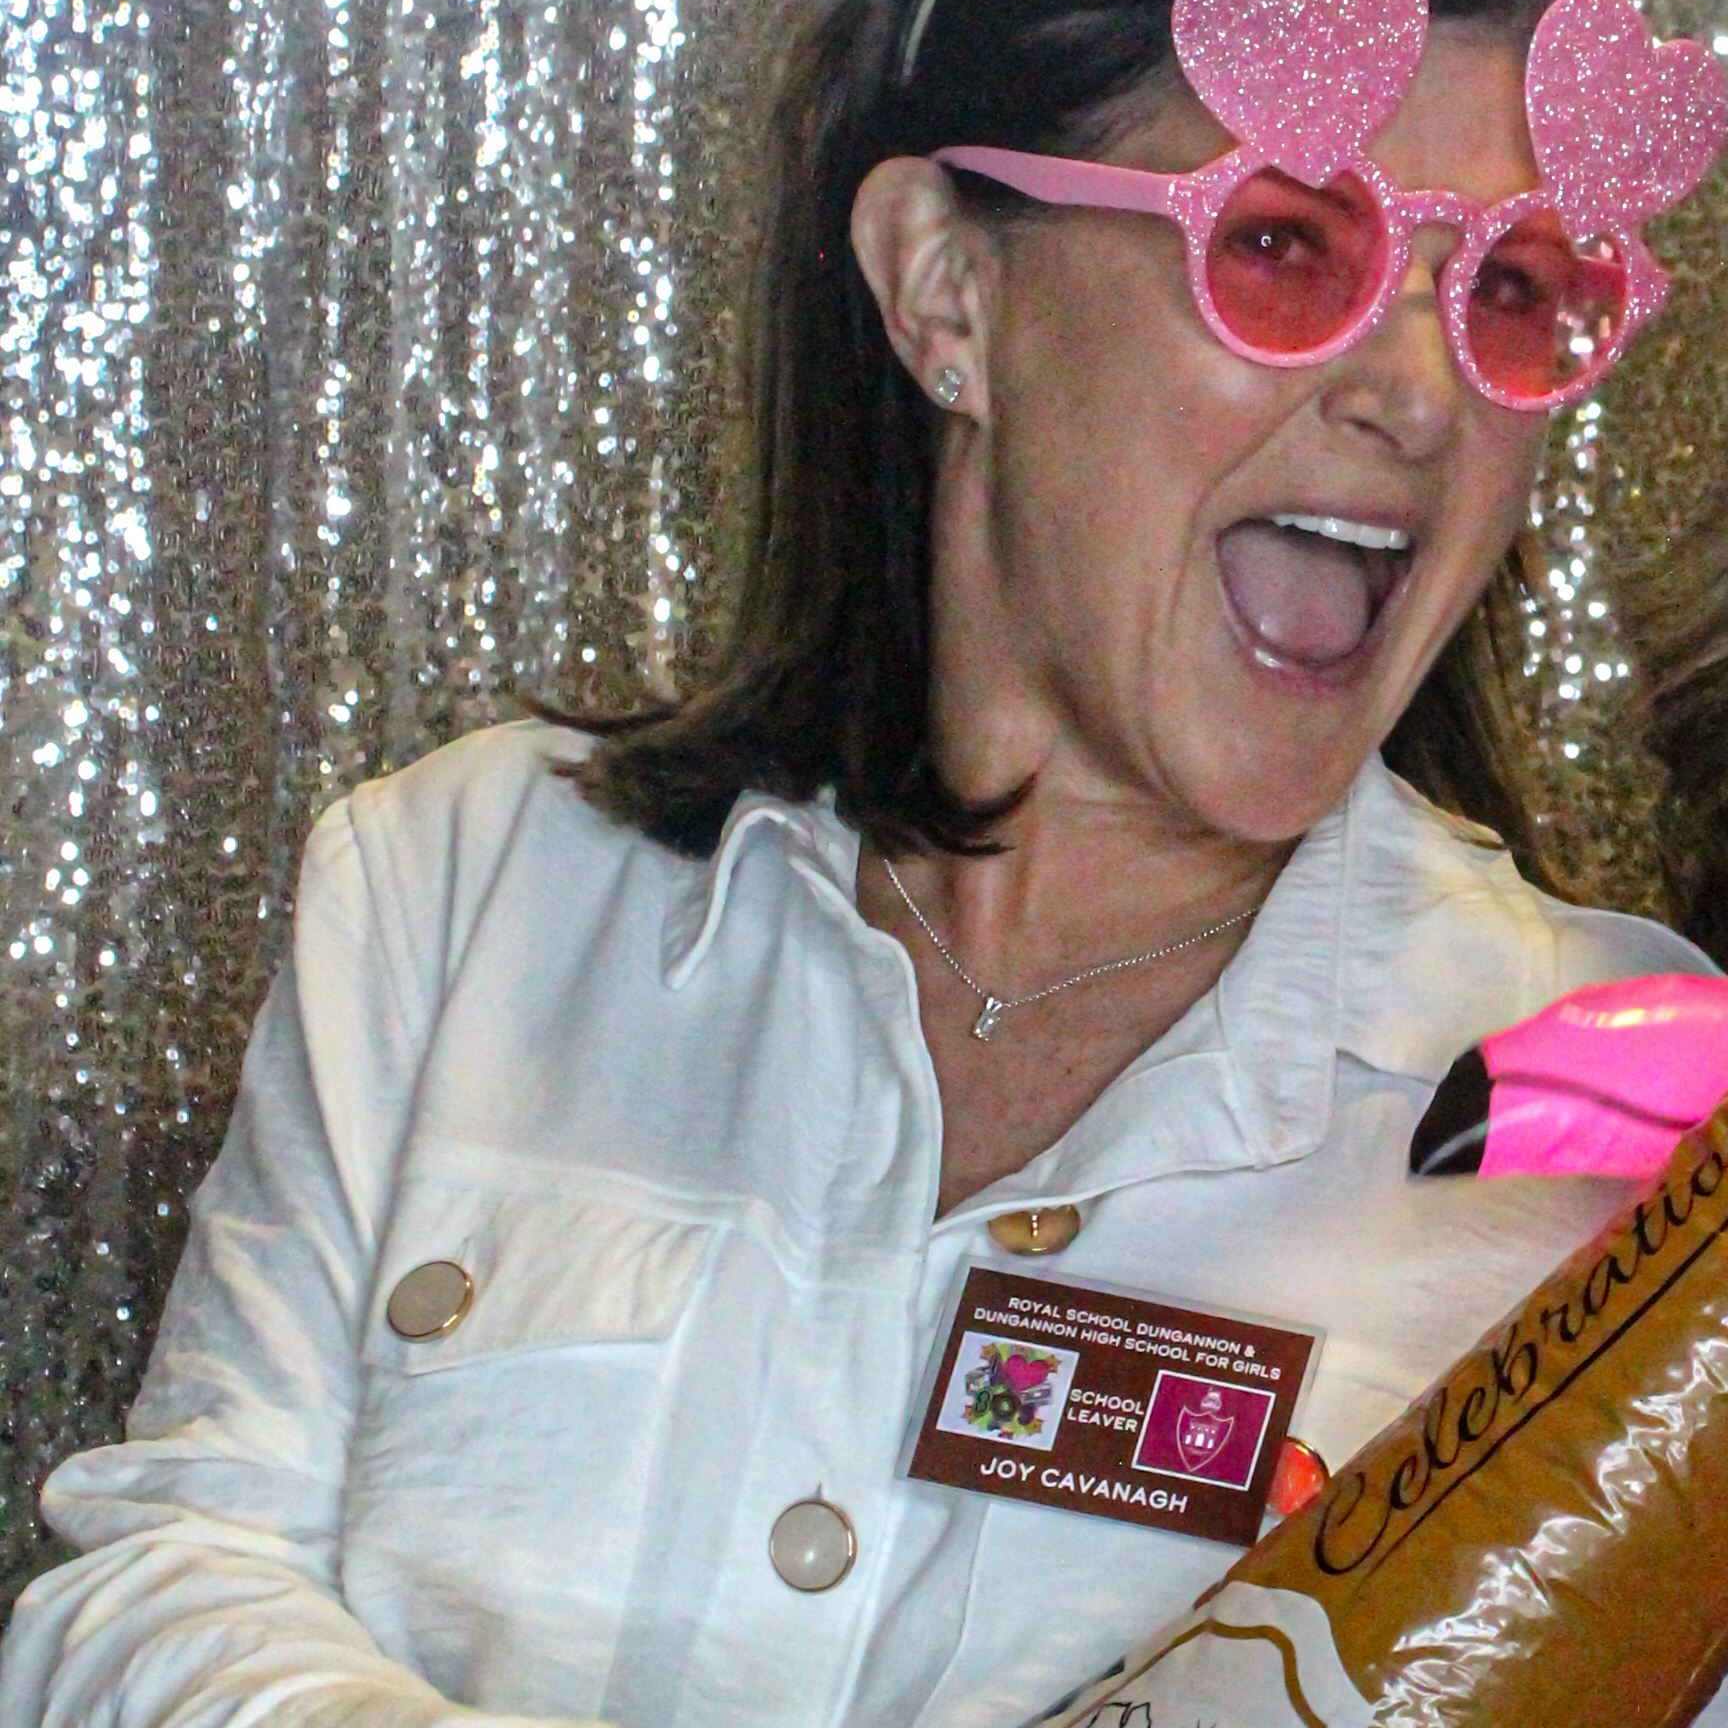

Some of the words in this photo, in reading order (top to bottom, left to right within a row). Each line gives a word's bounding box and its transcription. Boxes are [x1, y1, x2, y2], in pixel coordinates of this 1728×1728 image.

[974, 1307, 1080, 1338] DUNGANNON
[1081, 1328, 1121, 1347] HIGH
[1124, 1338, 1191, 1363] SCHOOL
[1195, 1353, 1229, 1370] FOR
[1232, 1360, 1282, 1381] GIRLS
[1008, 1297, 1061, 1319] ROYAL
[1066, 1308, 1132, 1333] SCHOOL
[1137, 1323, 1241, 1354] DUNGANNON
[1243, 1345, 1256, 1358] &
[1066, 1407, 1138, 1432] LEAVER
[1069, 1388, 1144, 1416] SCHOOL
[980, 1457, 1035, 1482] JOY
[1041, 1468, 1188, 1513] CAVANAGH
